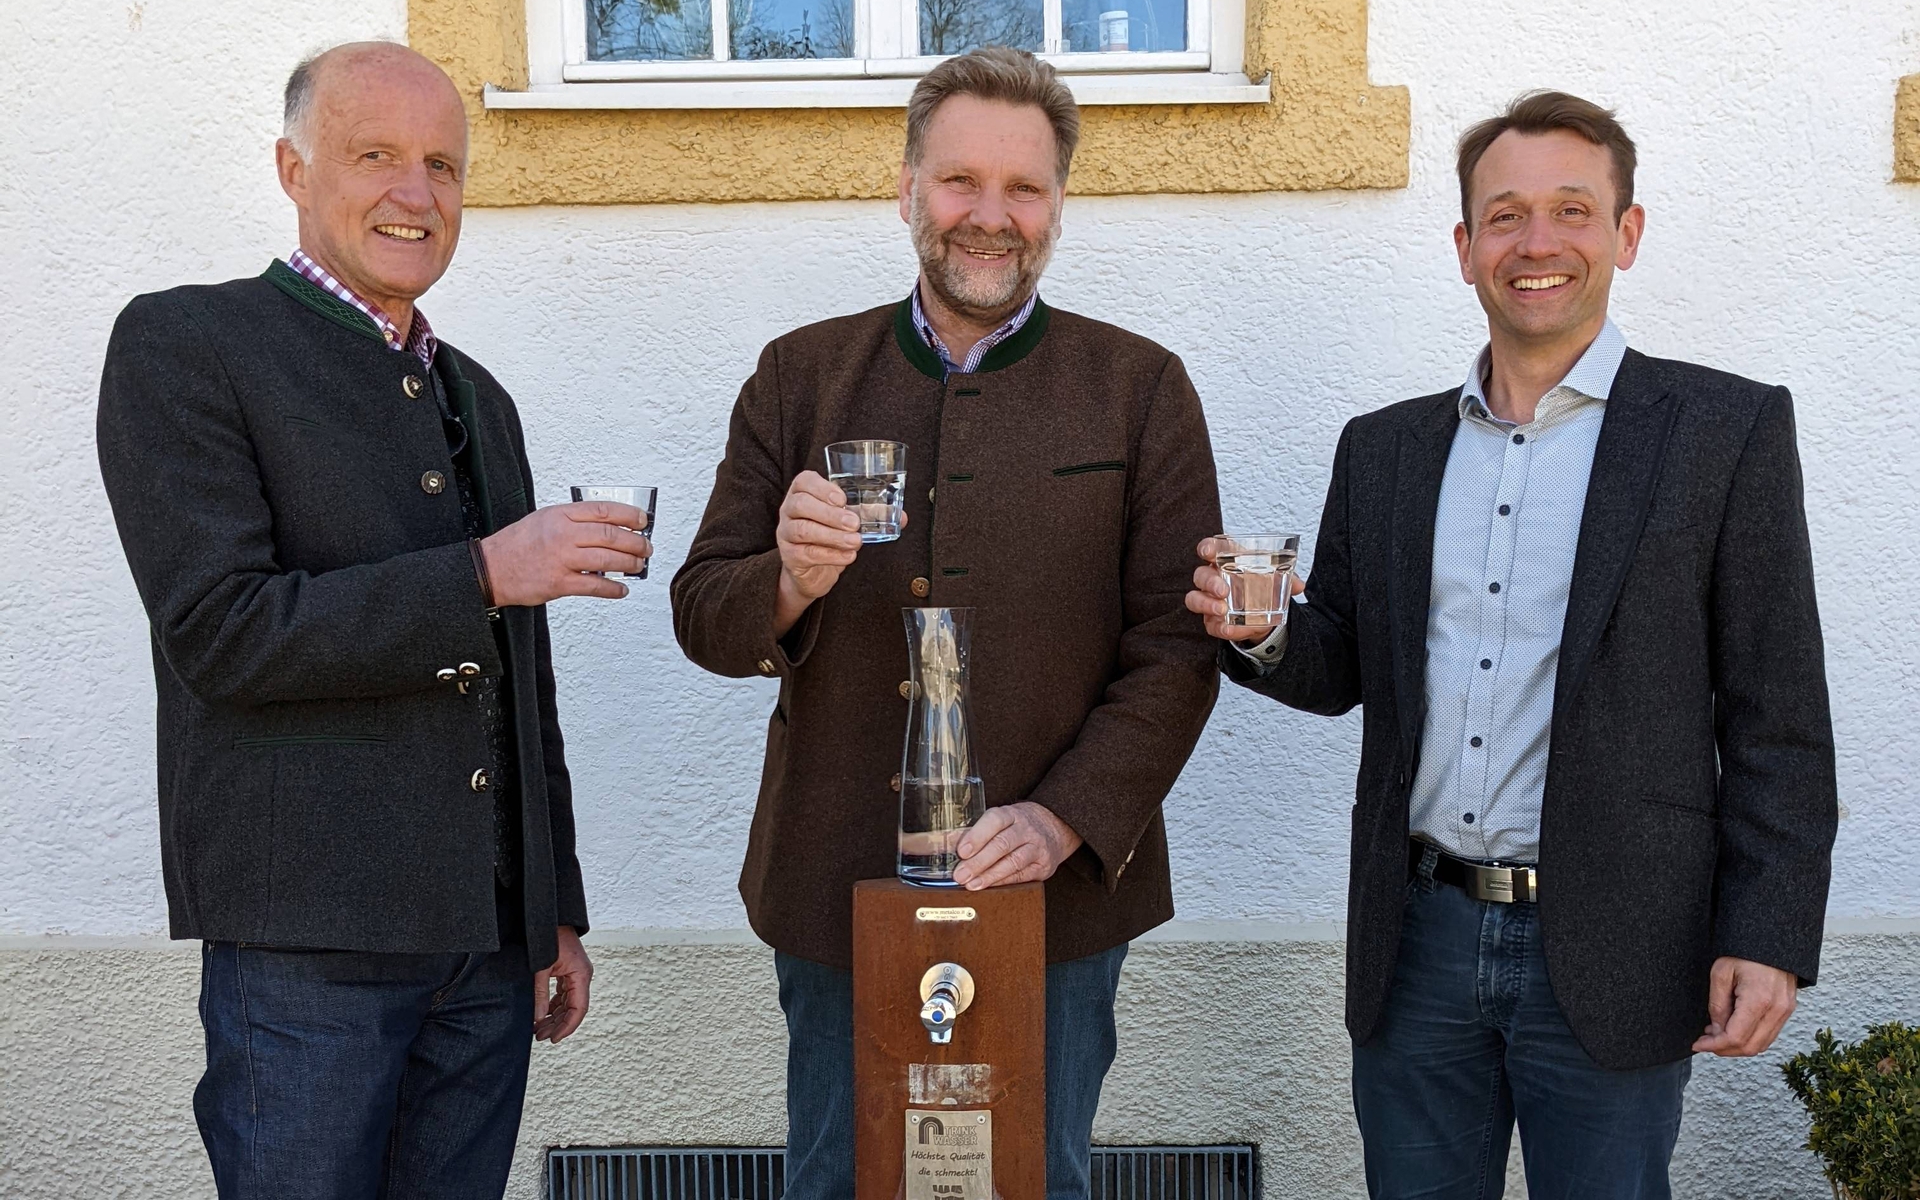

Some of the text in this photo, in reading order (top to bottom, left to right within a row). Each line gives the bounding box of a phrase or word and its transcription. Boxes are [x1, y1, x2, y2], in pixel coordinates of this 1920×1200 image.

[945, 1126, 977, 1136] TRINK
[933, 1136, 978, 1146] WASSER
[911, 1150, 985, 1162] Höchste Qualität
[918, 1167, 978, 1177] die schmeckt!
